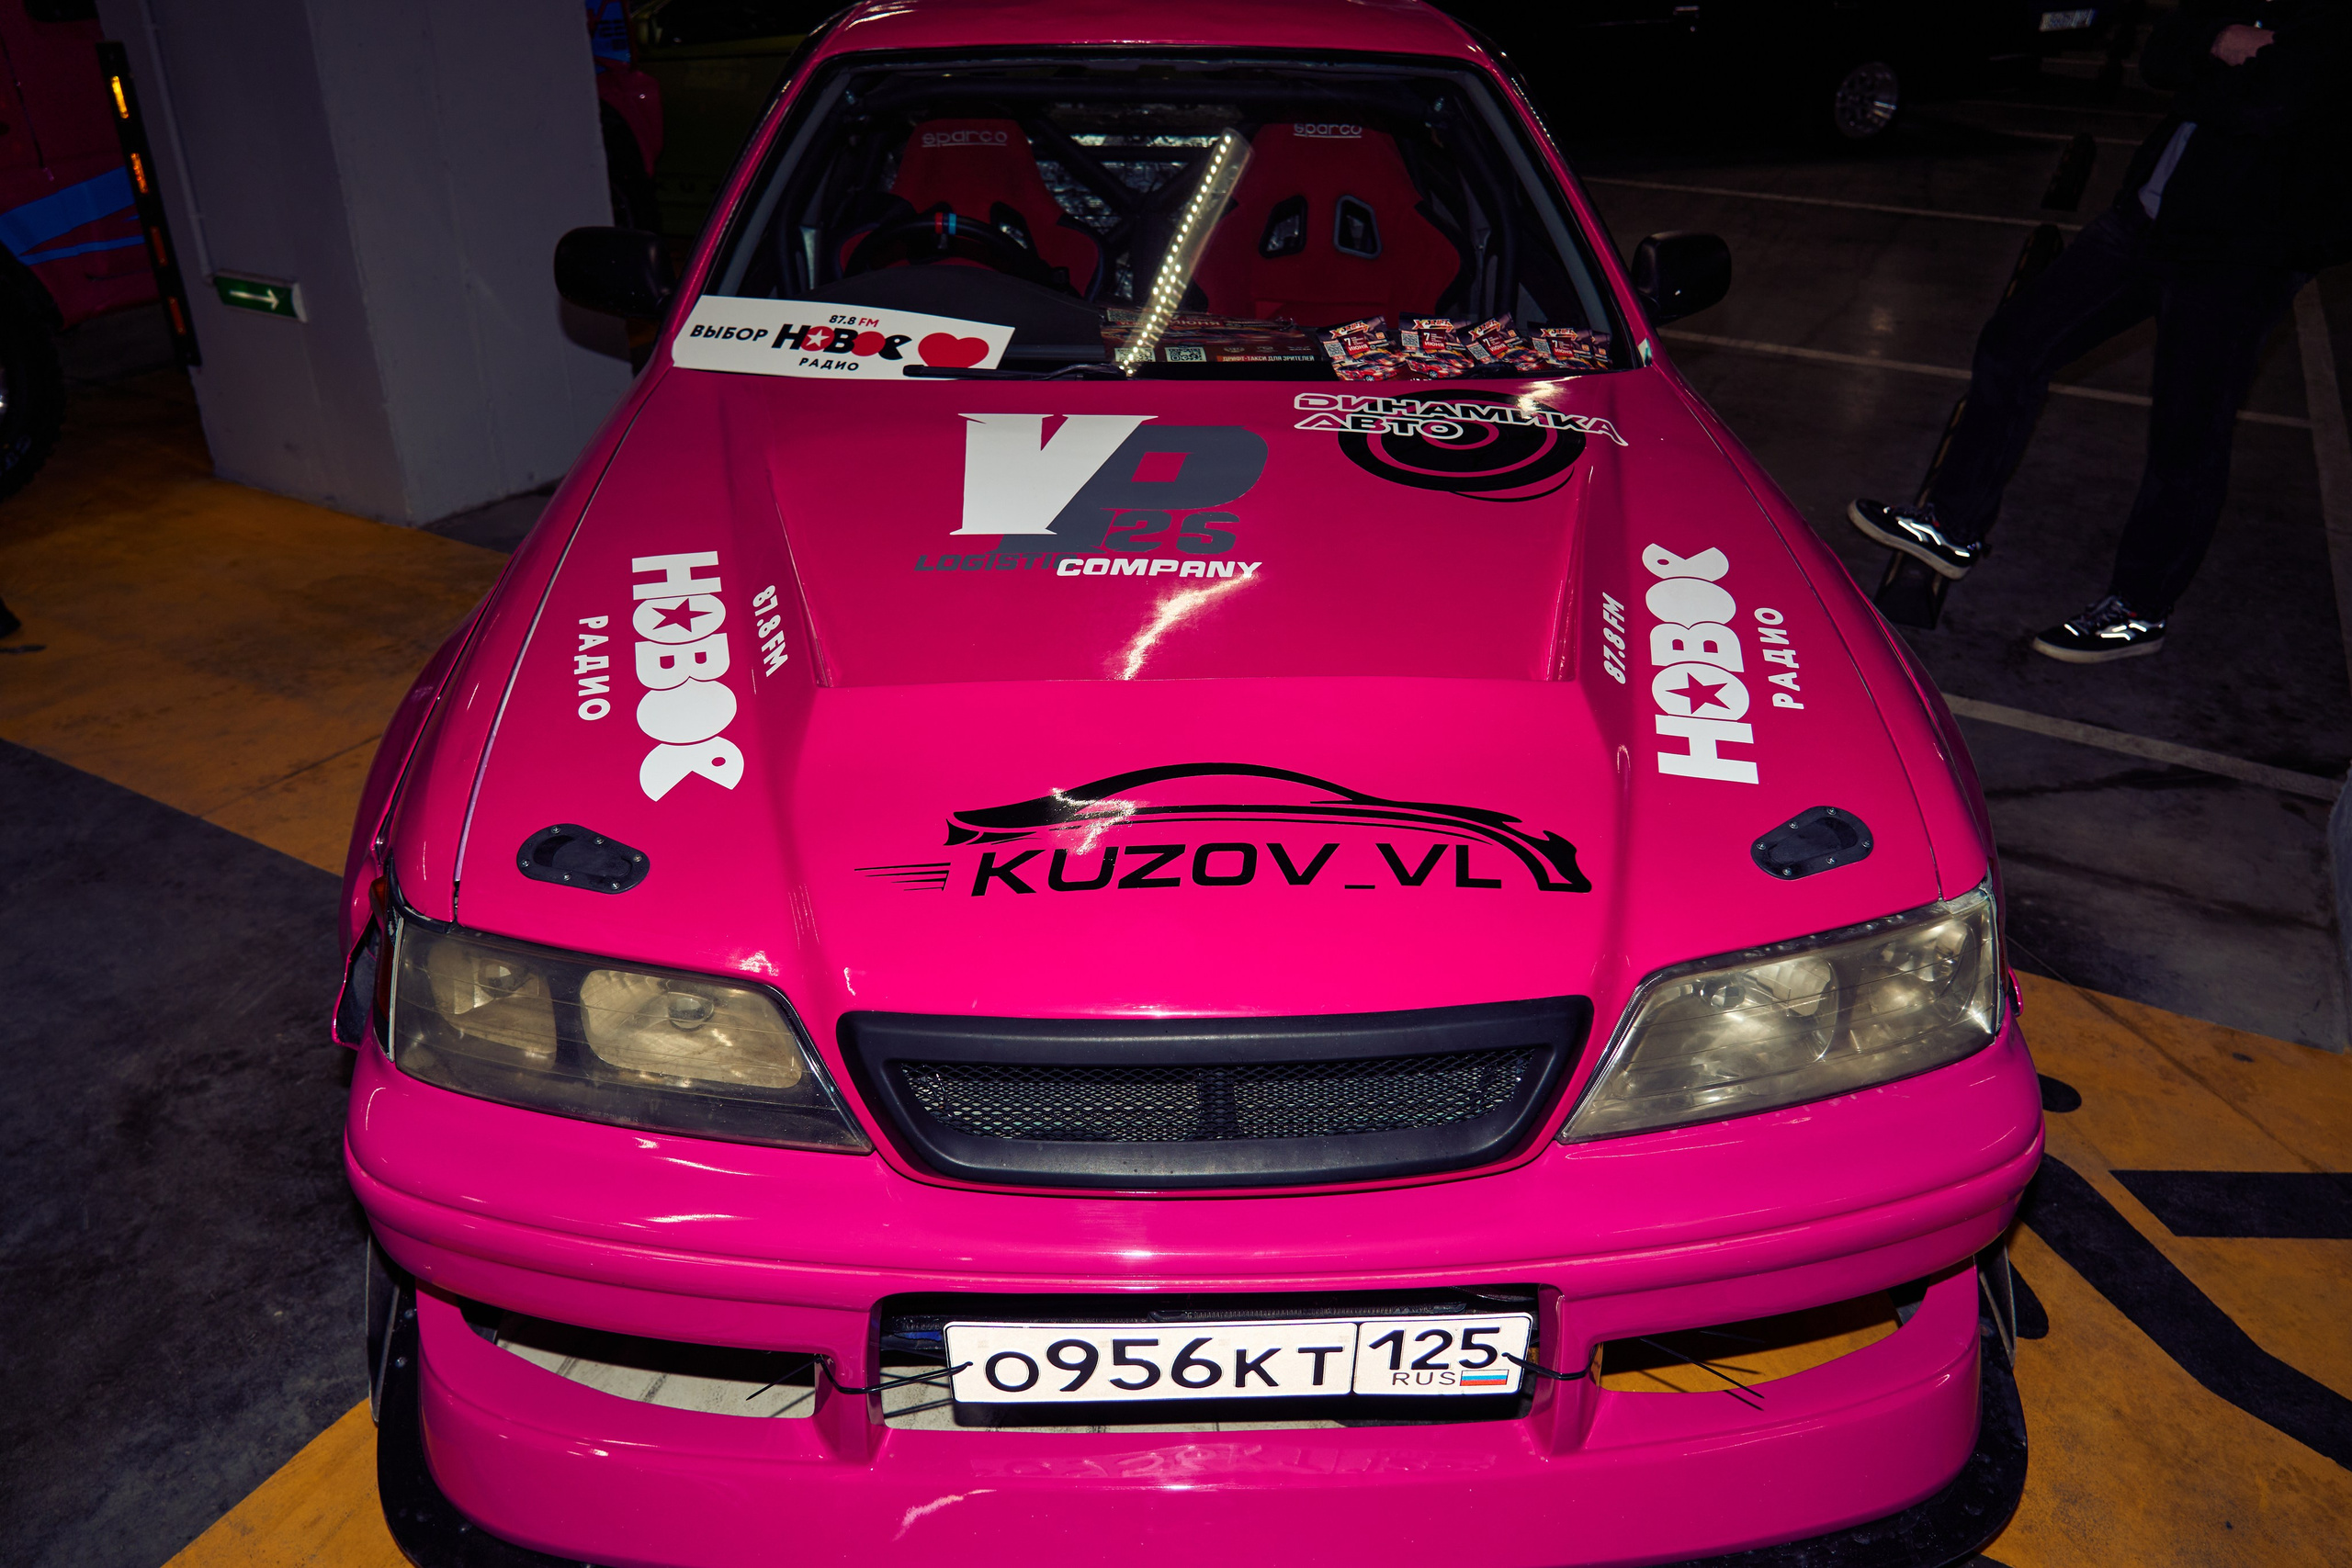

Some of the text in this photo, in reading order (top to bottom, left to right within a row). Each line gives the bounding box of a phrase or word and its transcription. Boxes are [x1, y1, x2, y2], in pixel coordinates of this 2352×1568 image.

[922, 130, 1008, 147] sparco
[829, 314, 879, 328] 87.8 FM
[689, 324, 769, 342] ВЫБОР
[1343, 338, 1351, 346] 7
[1423, 333, 1430, 342] 7
[1482, 338, 1491, 347] 7
[1552, 340, 1558, 348] 7
[798, 357, 859, 371] РАДИО
[1294, 413, 1464, 440] АВТО
[1056, 558, 1262, 578] COMPANY
[752, 585, 788, 677] 87.8 FM
[1602, 592, 1626, 684] 87.8 FM
[1754, 607, 1804, 709] РАДИО
[574, 615, 611, 720] РАДИО
[970, 842, 1502, 897] KUZOV_VL
[1367, 1326, 1501, 1371] 125
[1392, 1371, 1455, 1387] RUS
